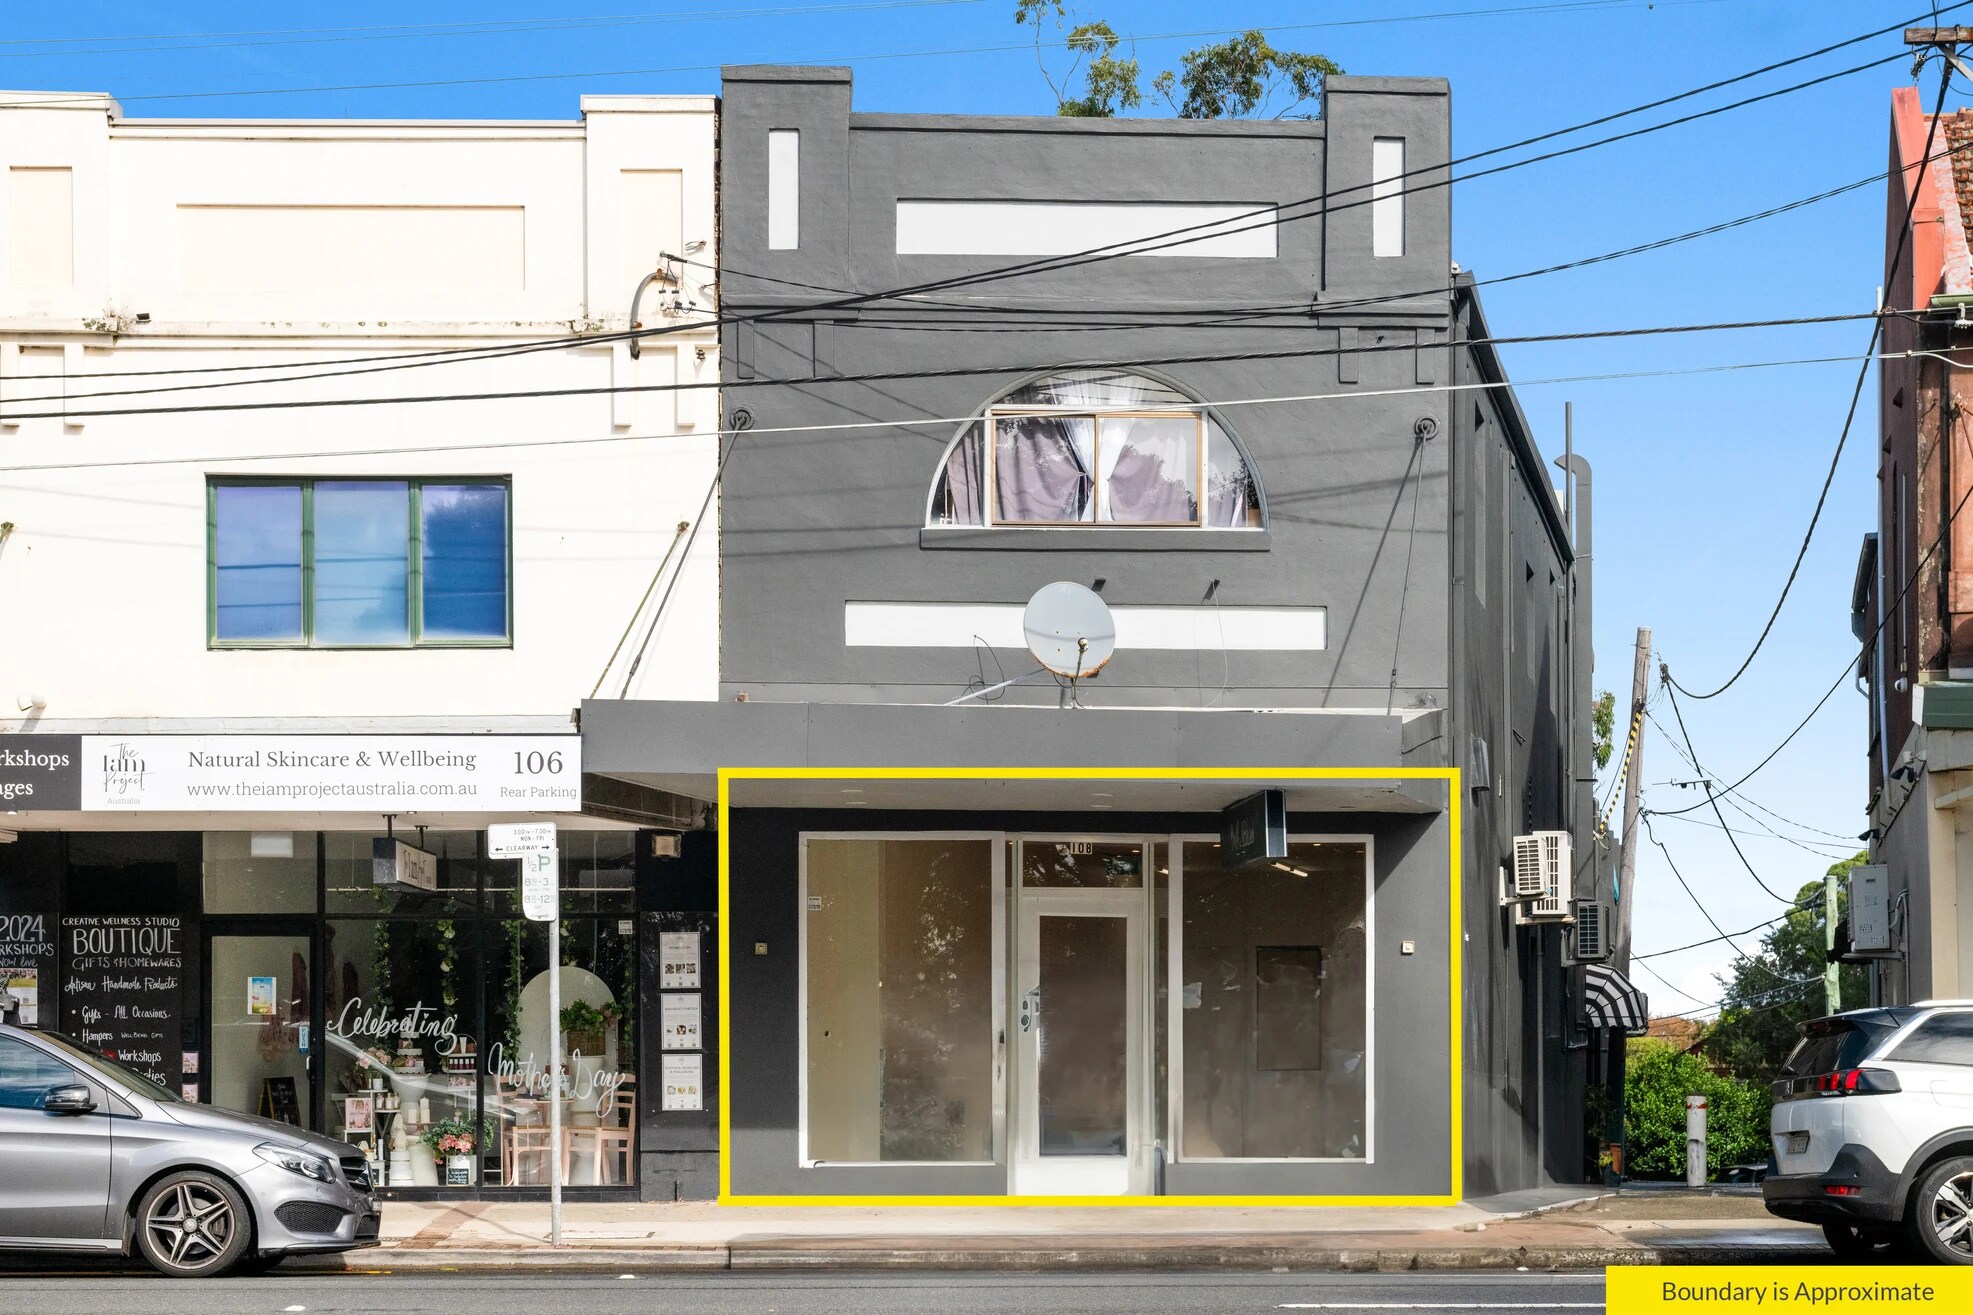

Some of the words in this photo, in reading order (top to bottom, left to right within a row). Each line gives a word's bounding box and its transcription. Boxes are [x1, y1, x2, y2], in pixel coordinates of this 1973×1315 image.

[188, 751, 261, 768] Natural
[266, 751, 350, 768] Skincare
[355, 751, 372, 768] &
[377, 751, 477, 771] Wellbeing
[514, 751, 563, 775] 106
[187, 781, 478, 799] www.theiamprojectaustralia.com.au
[500, 787, 527, 798] Rear
[530, 786, 577, 800] Parking
[107, 797, 141, 805] Australia
[1072, 842, 1091, 853] 108
[538, 855, 551, 872] P
[0, 915, 46, 942] 2024
[103, 917, 141, 925] WELLNESS
[145, 917, 180, 927] STUDIO
[73, 928, 181, 954] BOUTIQUE
[72, 957, 110, 971] GIFTS
[64, 975, 96, 995] Artisan
[101, 975, 141, 993] Handmade
[144, 976, 178, 992] Products
[82, 1005, 101, 1024] Gifts
[114, 1005, 128, 1019] All
[326, 997, 458, 1055] Celebrating
[82, 1028, 113, 1046] Hampers
[118, 1049, 162, 1066] Workshops
[570, 1048, 625, 1118] Day
